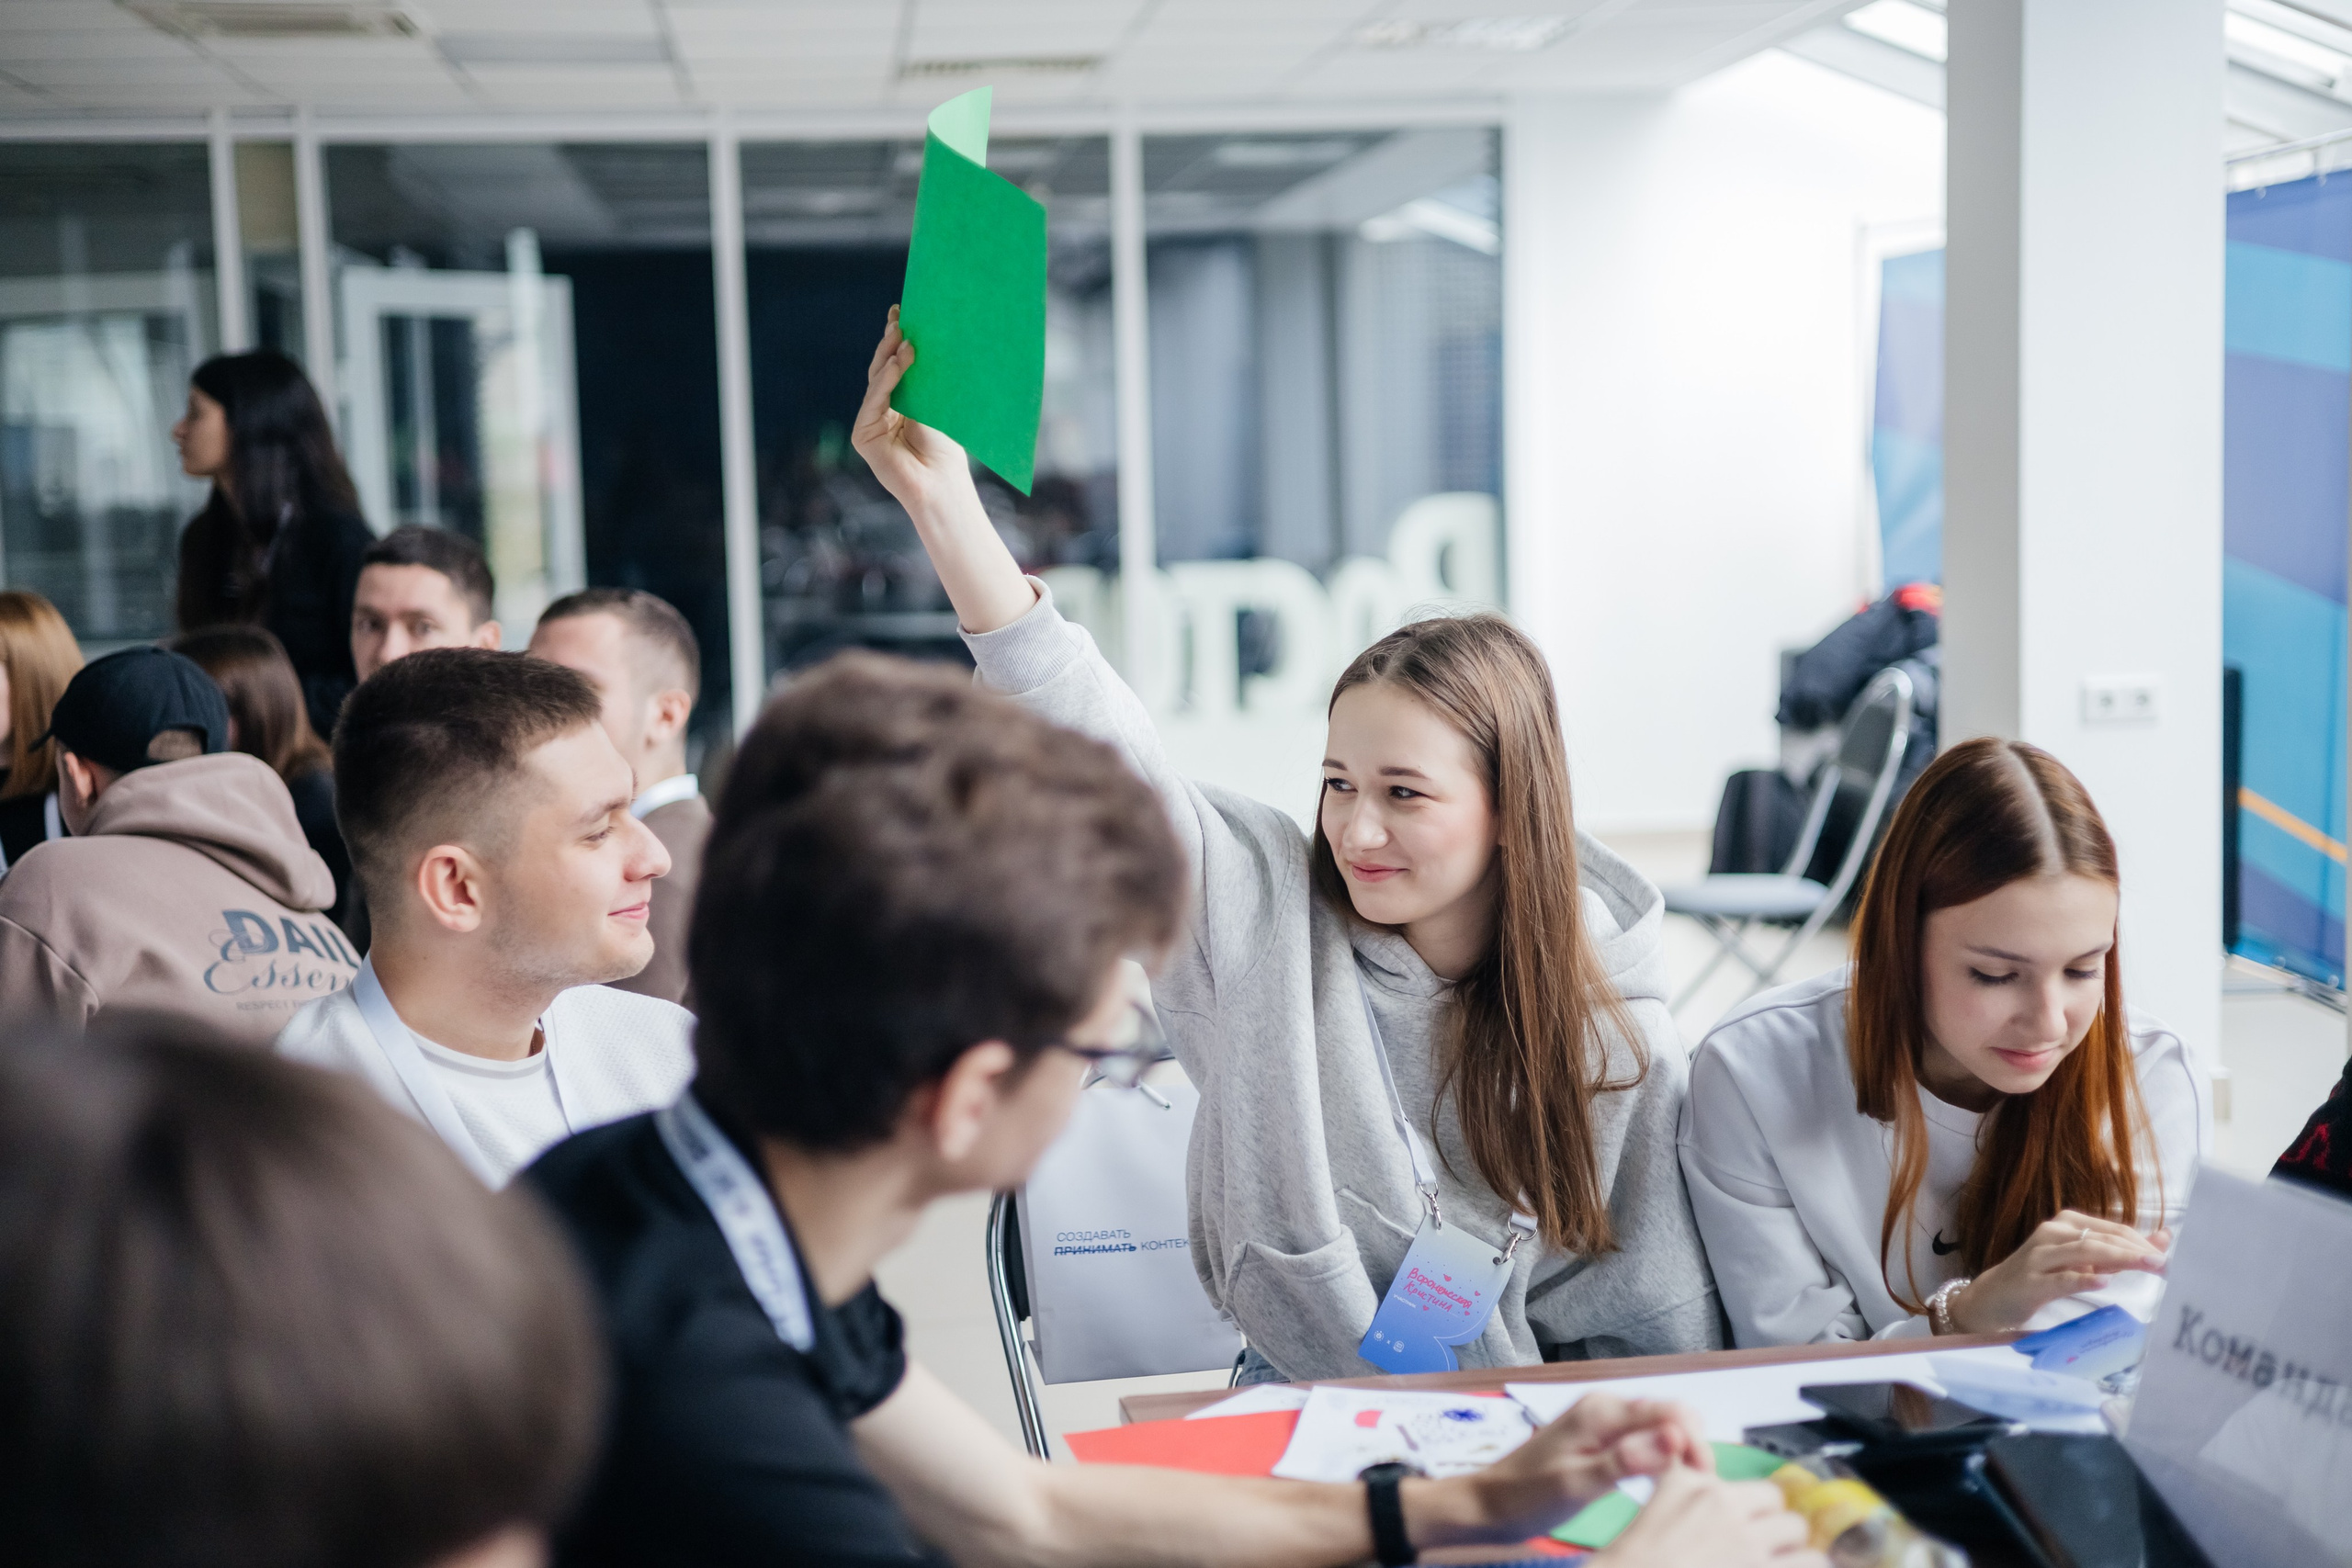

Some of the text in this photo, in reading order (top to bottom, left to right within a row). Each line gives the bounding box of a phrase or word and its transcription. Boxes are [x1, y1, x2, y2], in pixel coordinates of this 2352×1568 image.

[236, 999, 289, 1010] RESPECT
[1057, 1229, 1131, 1243] СОЗДАВАТЬ
[1054, 1243, 1136, 1256] ПРИНИМАТЬ
